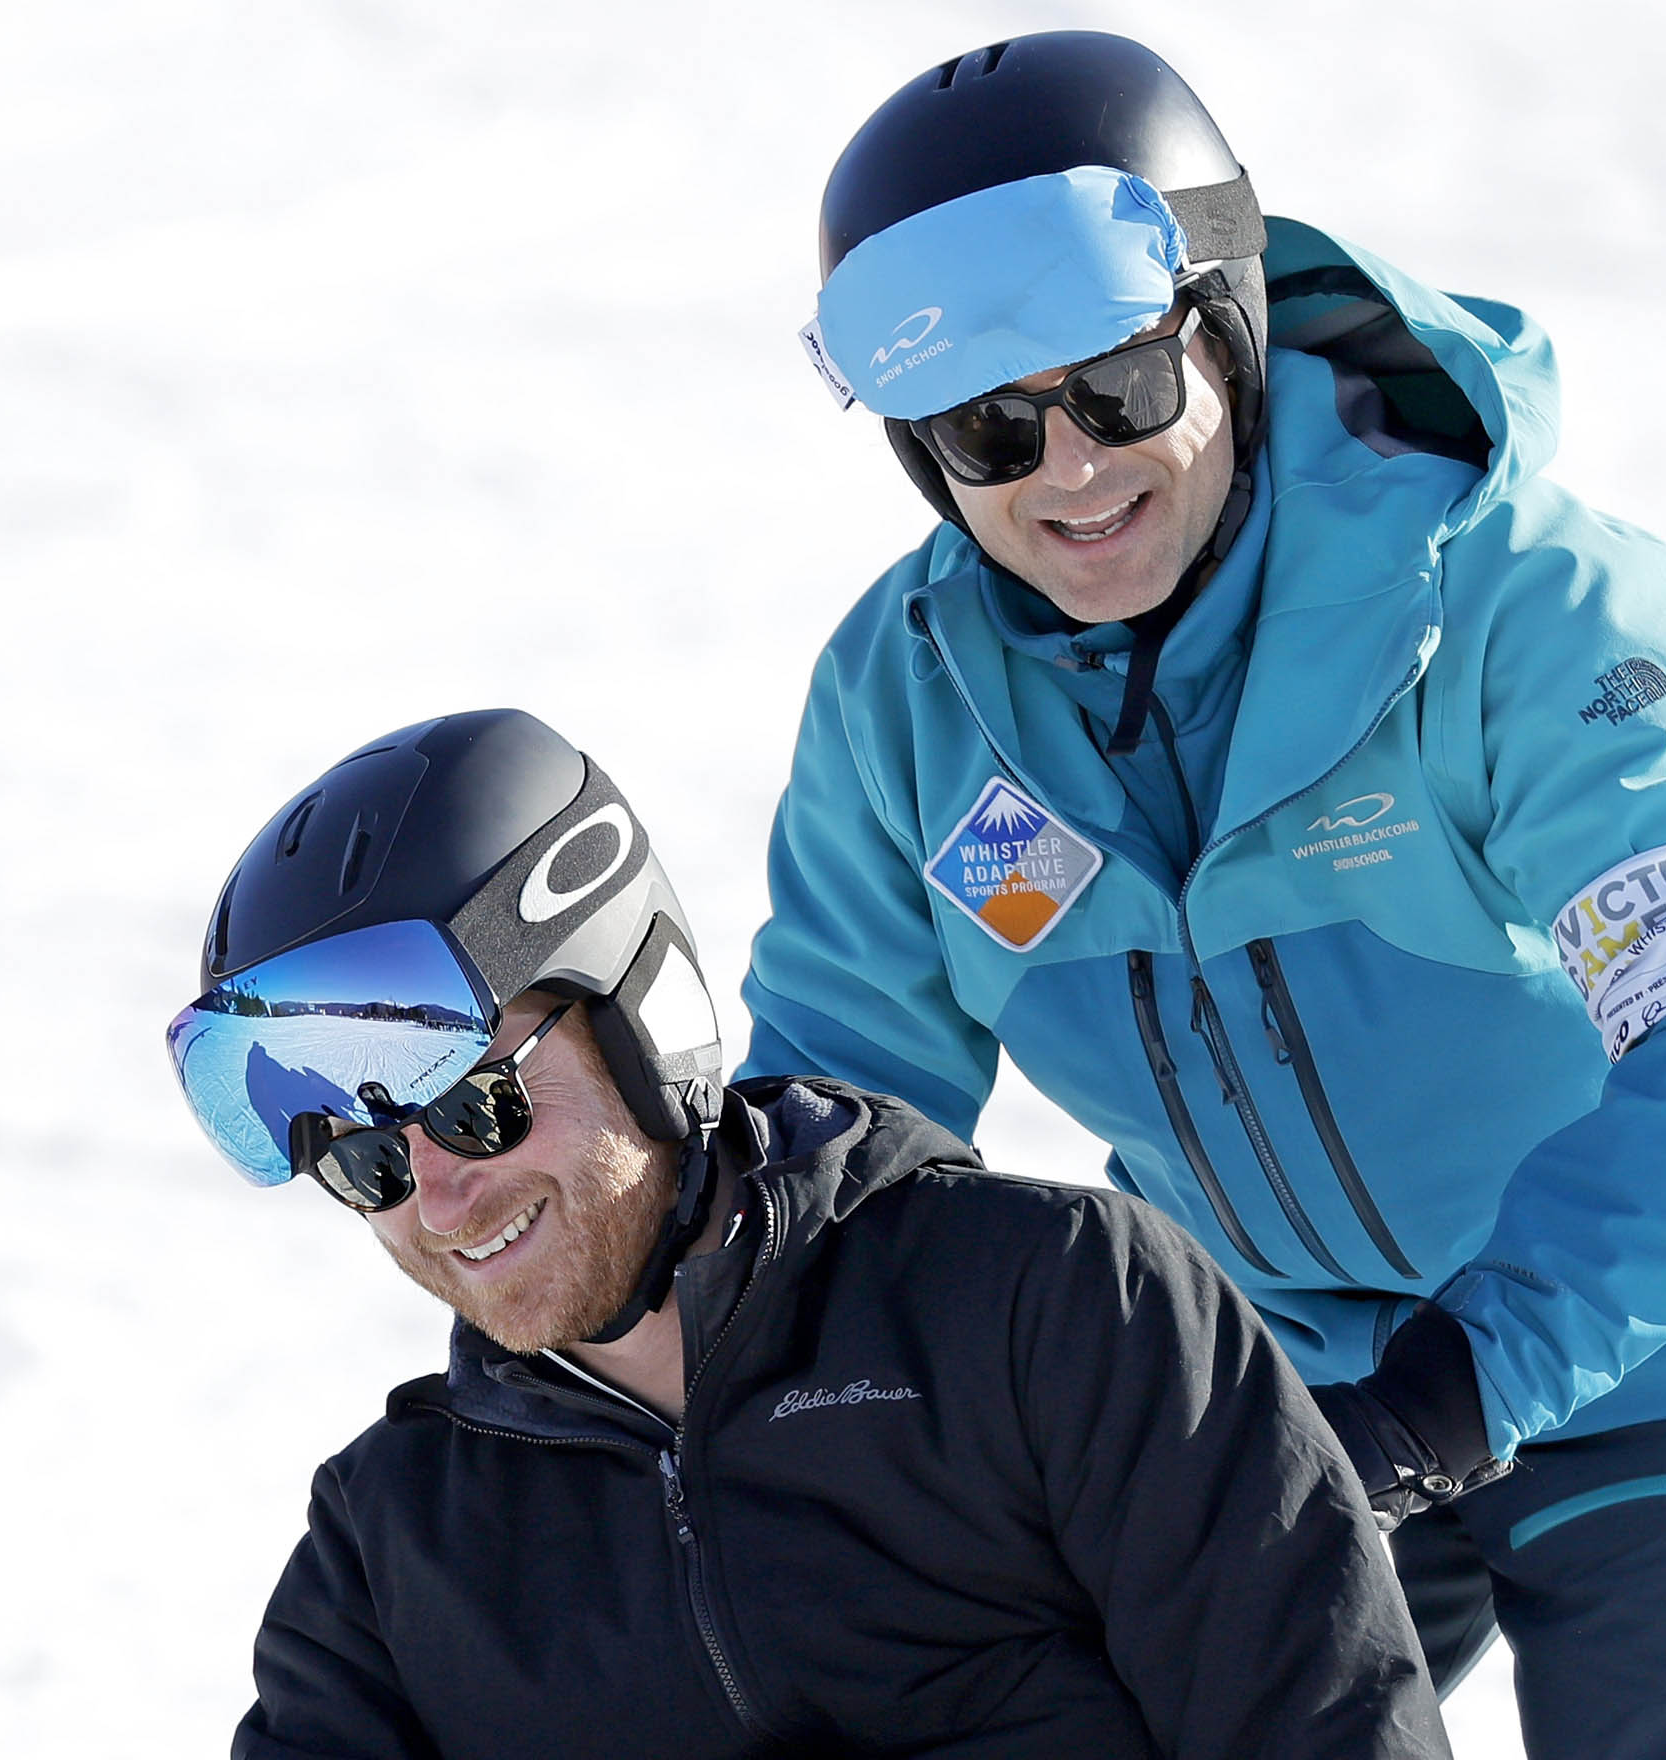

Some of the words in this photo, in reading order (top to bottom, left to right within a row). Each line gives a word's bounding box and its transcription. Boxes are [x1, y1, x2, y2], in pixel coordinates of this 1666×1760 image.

[876, 363, 904, 388] SNOW
[905, 337, 954, 370] SCHOOL
[1593, 664, 1630, 692] THE
[1578, 676, 1643, 725] NORTH
[1606, 690, 1651, 727] FACE
[959, 837, 1062, 863] WHISTLER
[962, 858, 1065, 884] ADAPTIVE
[964, 883, 1009, 899] SPORTS
[1012, 877, 1067, 895] PROGRAM
[768, 1388, 839, 1423] Eddie
[839, 1379, 923, 1405] Bauer
